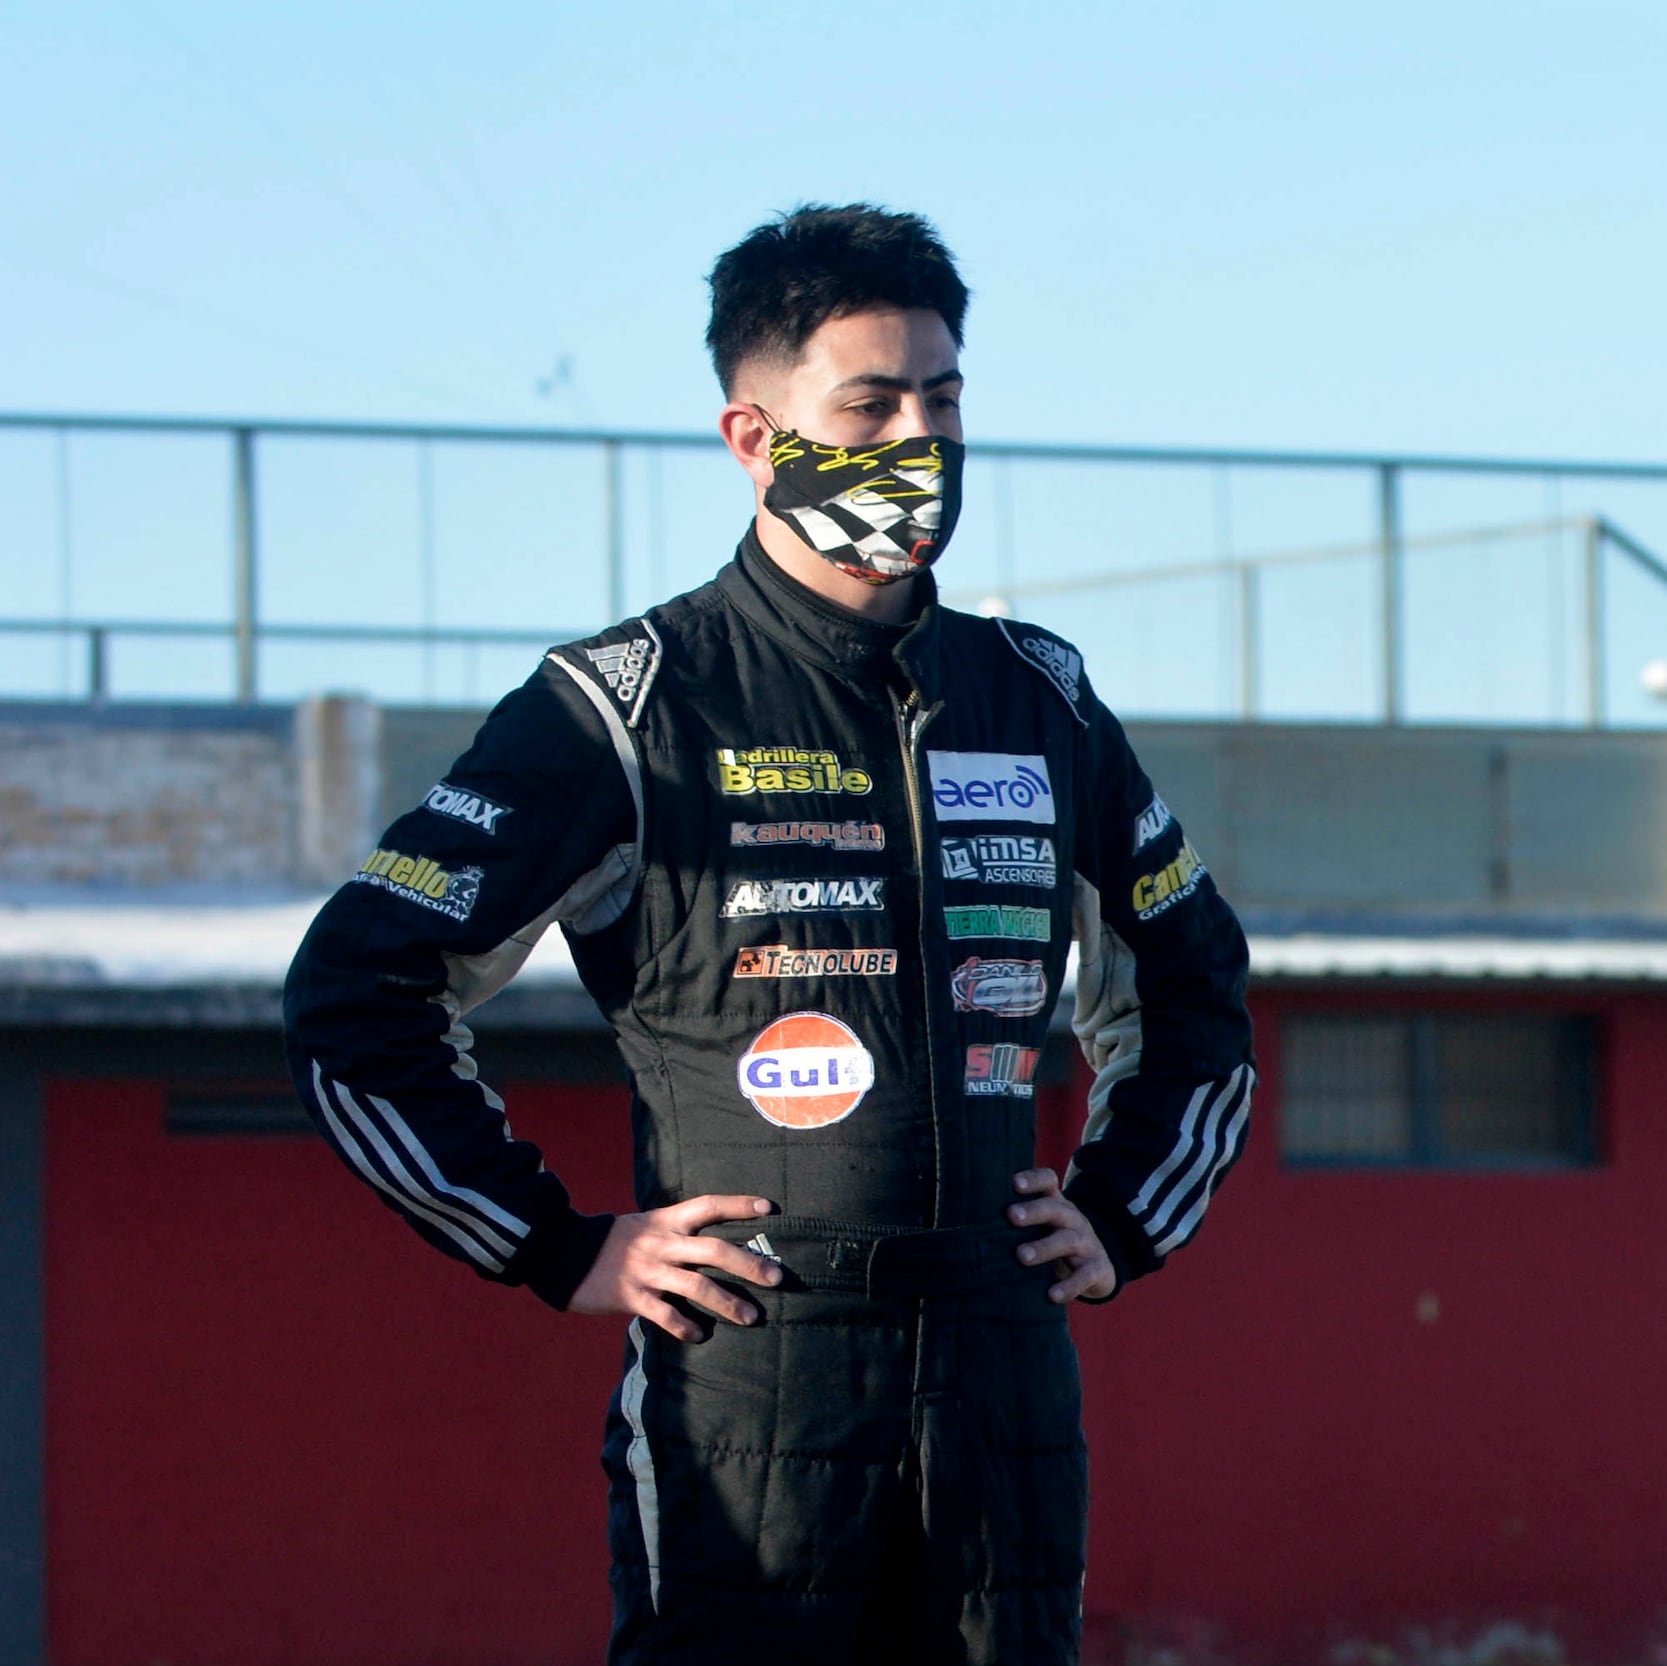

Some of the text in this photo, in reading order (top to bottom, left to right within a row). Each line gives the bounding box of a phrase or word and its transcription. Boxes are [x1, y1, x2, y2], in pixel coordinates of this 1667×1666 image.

[617, 638, 650, 702] adidas
[1022, 637, 1080, 702] adidas
[720, 763, 870, 793] Basile
[934, 778, 1035, 808] aero
[387, 880, 469, 922] Vehicular
[767, 950, 893, 975] TECNOLUBE
[746, 1057, 860, 1089] Gul
